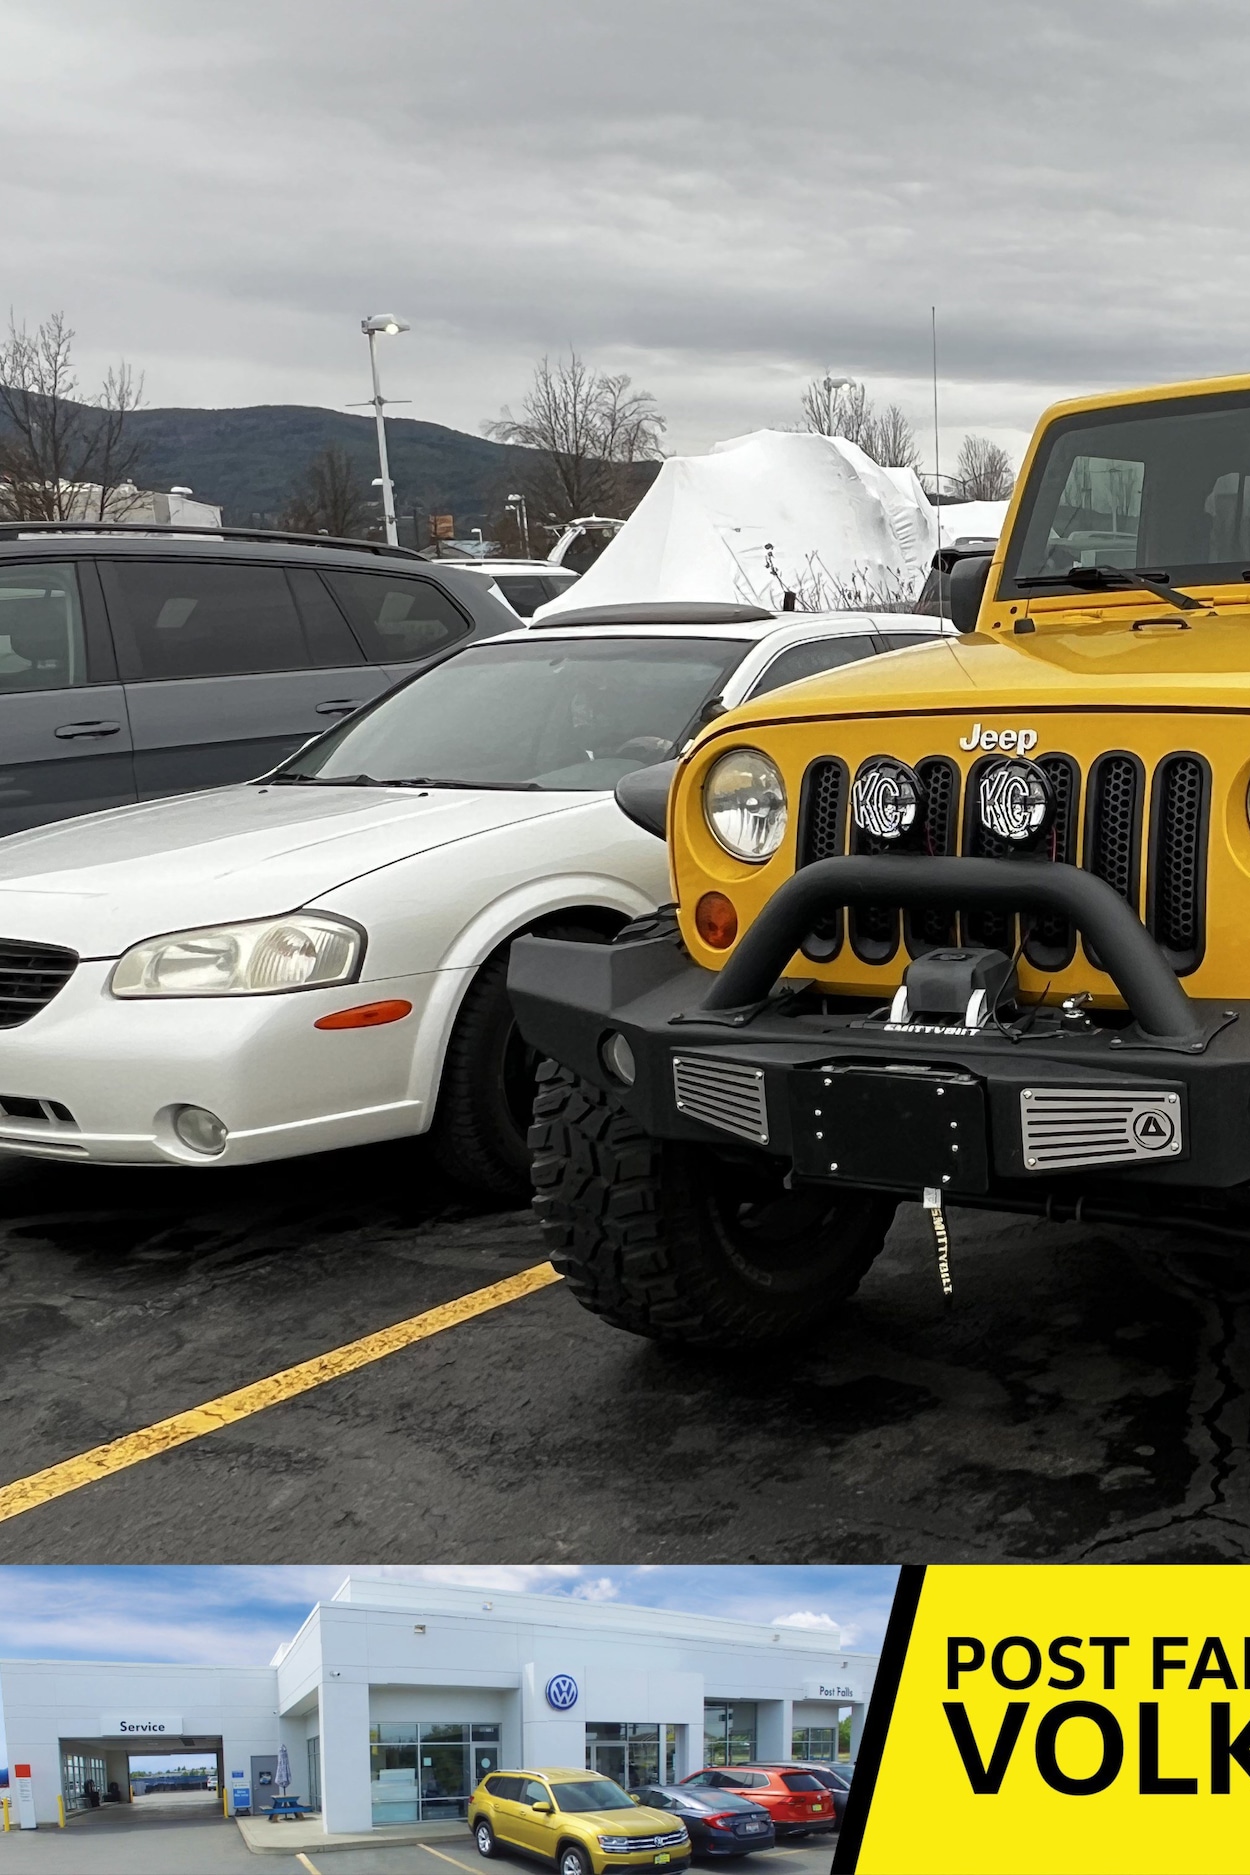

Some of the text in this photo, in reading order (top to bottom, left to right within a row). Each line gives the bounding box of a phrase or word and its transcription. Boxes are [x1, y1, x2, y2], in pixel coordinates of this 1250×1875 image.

[959, 723, 1038, 756] Jeep
[852, 771, 901, 838] KC
[980, 770, 1030, 838] KC
[930, 1208, 953, 1296] SMITTYBILT
[819, 1685, 853, 1697] Post Falls
[119, 1721, 166, 1732] Service
